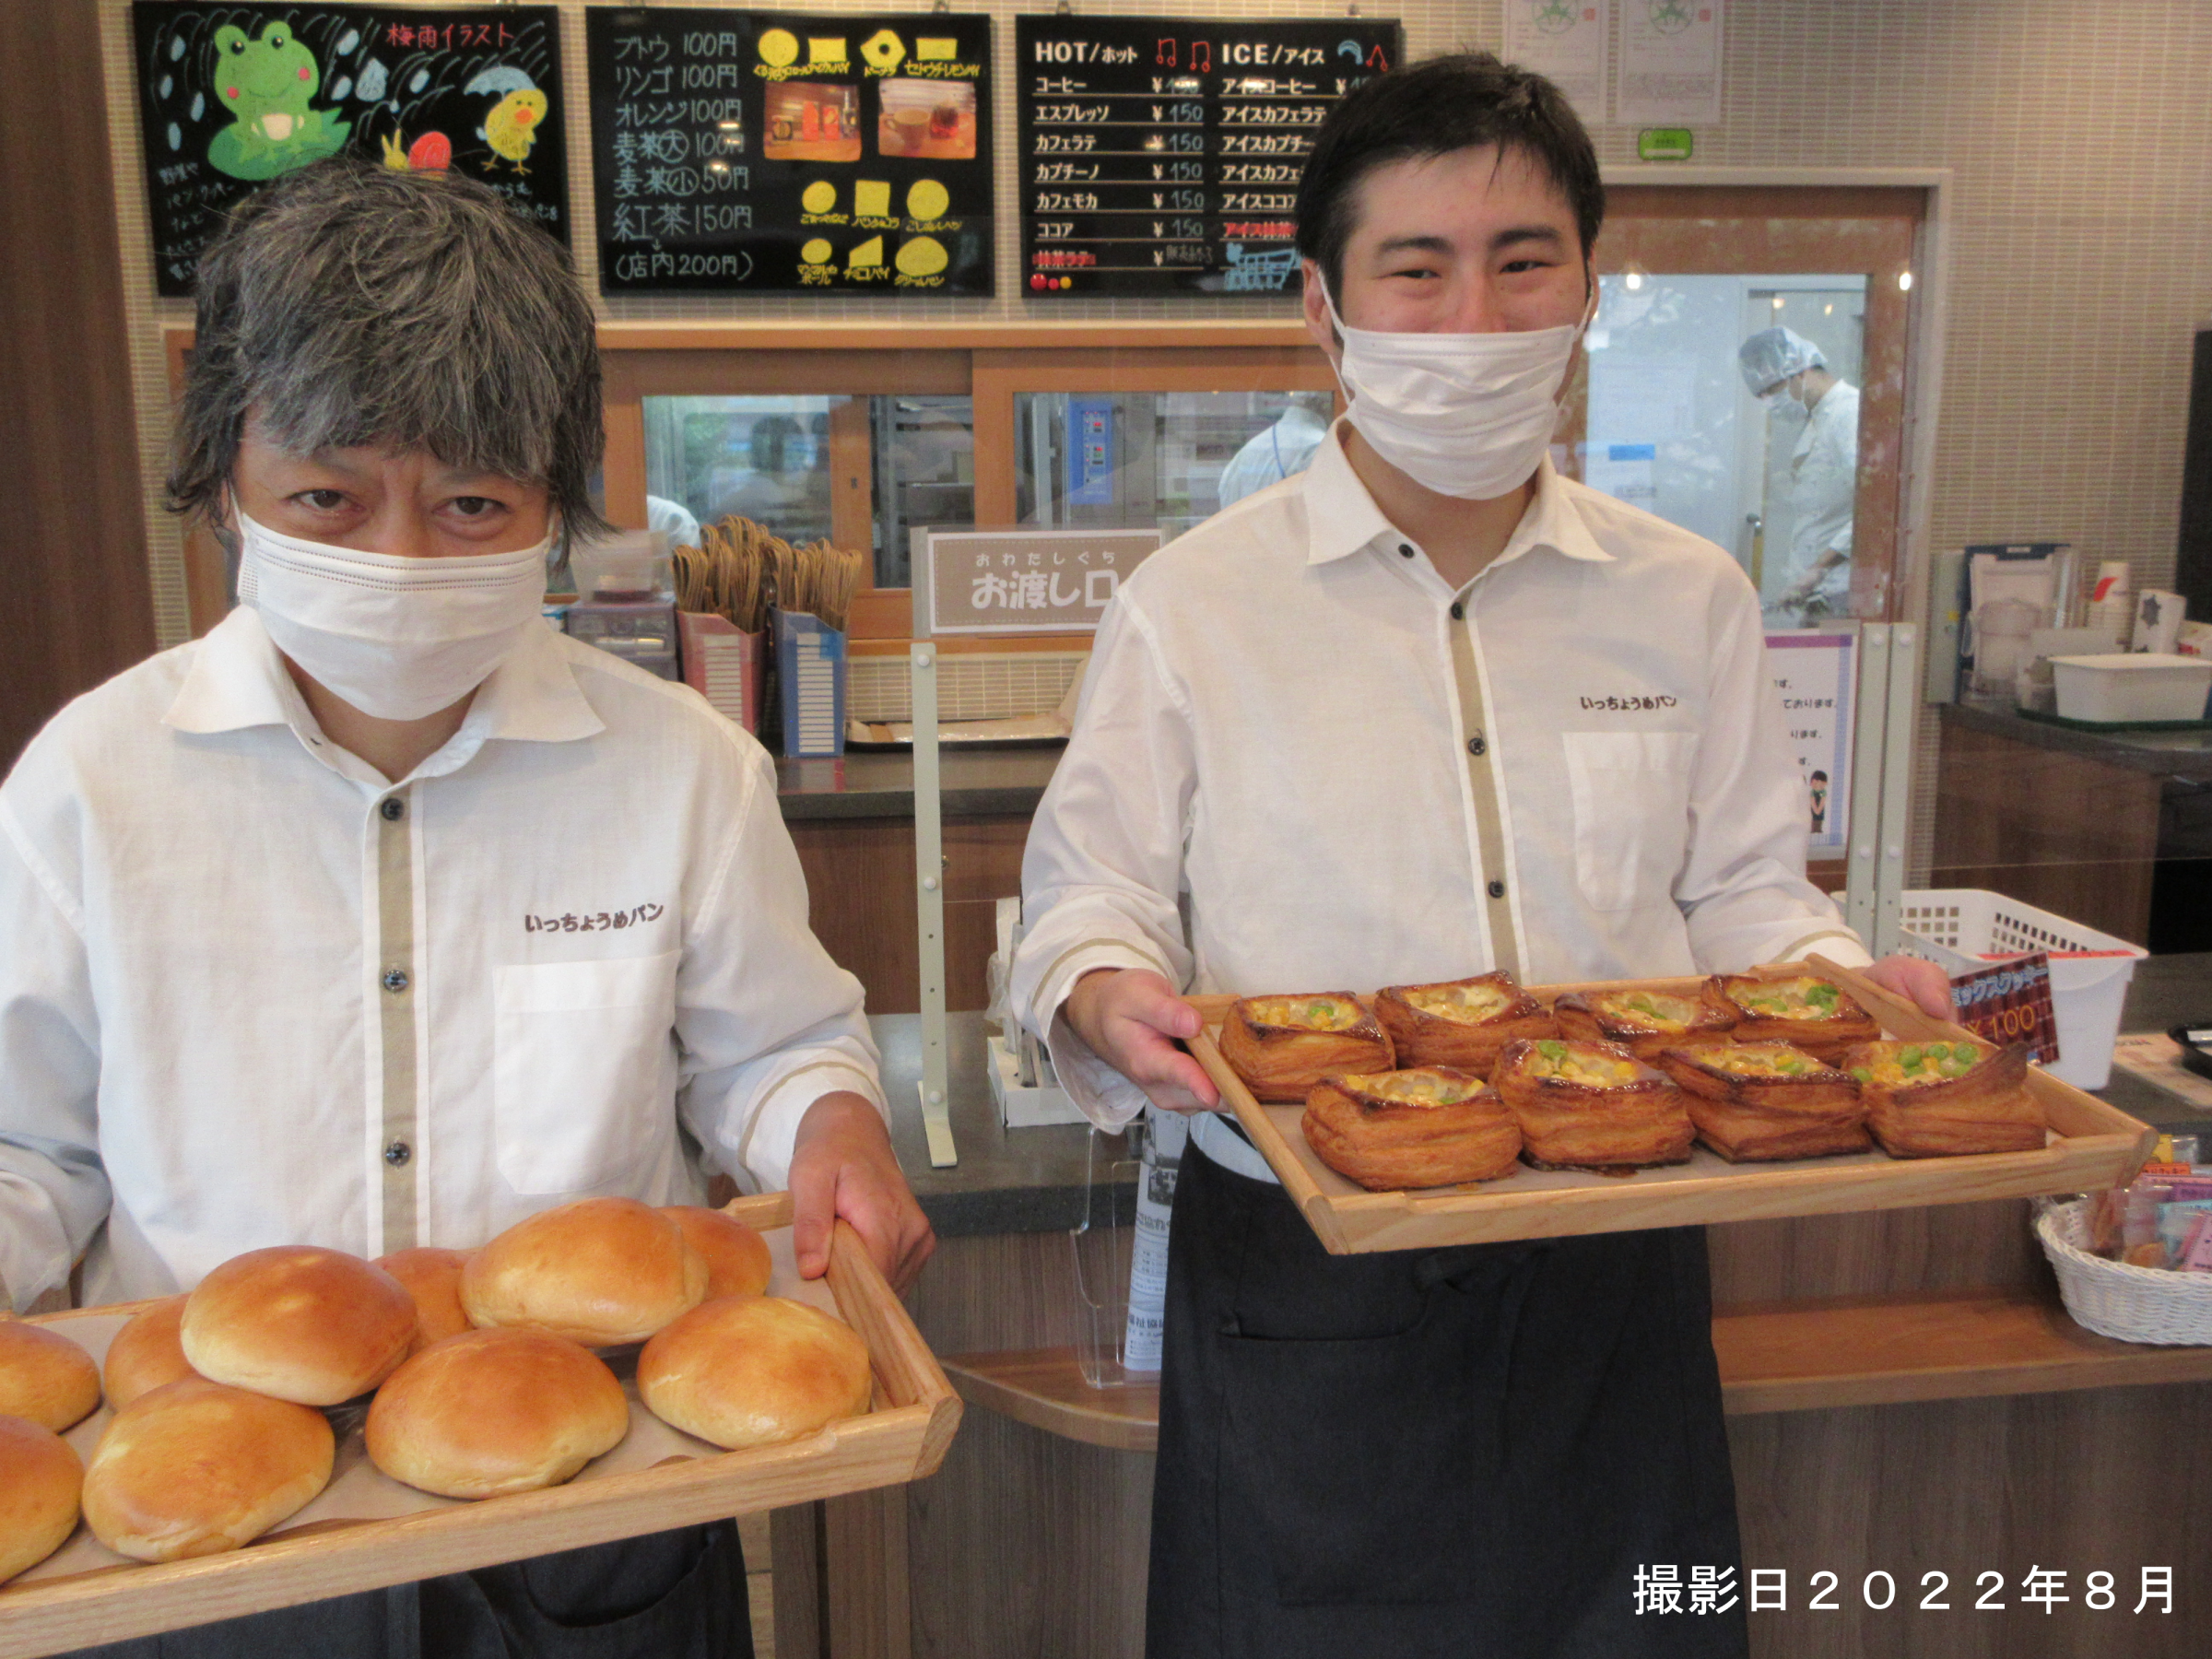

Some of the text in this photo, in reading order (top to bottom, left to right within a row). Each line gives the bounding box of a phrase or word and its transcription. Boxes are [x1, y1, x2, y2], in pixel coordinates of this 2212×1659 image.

[385, 22, 514, 52] 梅雨イラスト
[683, 31, 736, 57] 100円
[616, 64, 736, 100] リンゴ 100円
[1036, 76, 1087, 93] コーヒー
[616, 99, 742, 127] オレンジ 100円
[1036, 104, 1110, 122] エスプレッソ
[1169, 102, 1204, 123] 150
[1222, 106, 1327, 123] アイスカフェラテ
[1036, 135, 1097, 151] カフェラテ
[1169, 134, 1204, 152] 150
[1037, 162, 1100, 180] カプチーノ
[1170, 162, 1203, 181] 150
[1222, 164, 1304, 182] アイスカフェ
[1037, 192, 1098, 209] カフェモカ
[1171, 190, 1205, 209] 150
[612, 203, 752, 242] 紅茶 150円
[1038, 223, 1074, 237] ココア
[1171, 219, 1204, 237] 150
[976, 551, 1115, 568] おわたしぐち
[971, 569, 1120, 610] お渡し口
[1580, 695, 1677, 711] いっちょうめパン
[524, 902, 665, 933] いっちょうめパン
